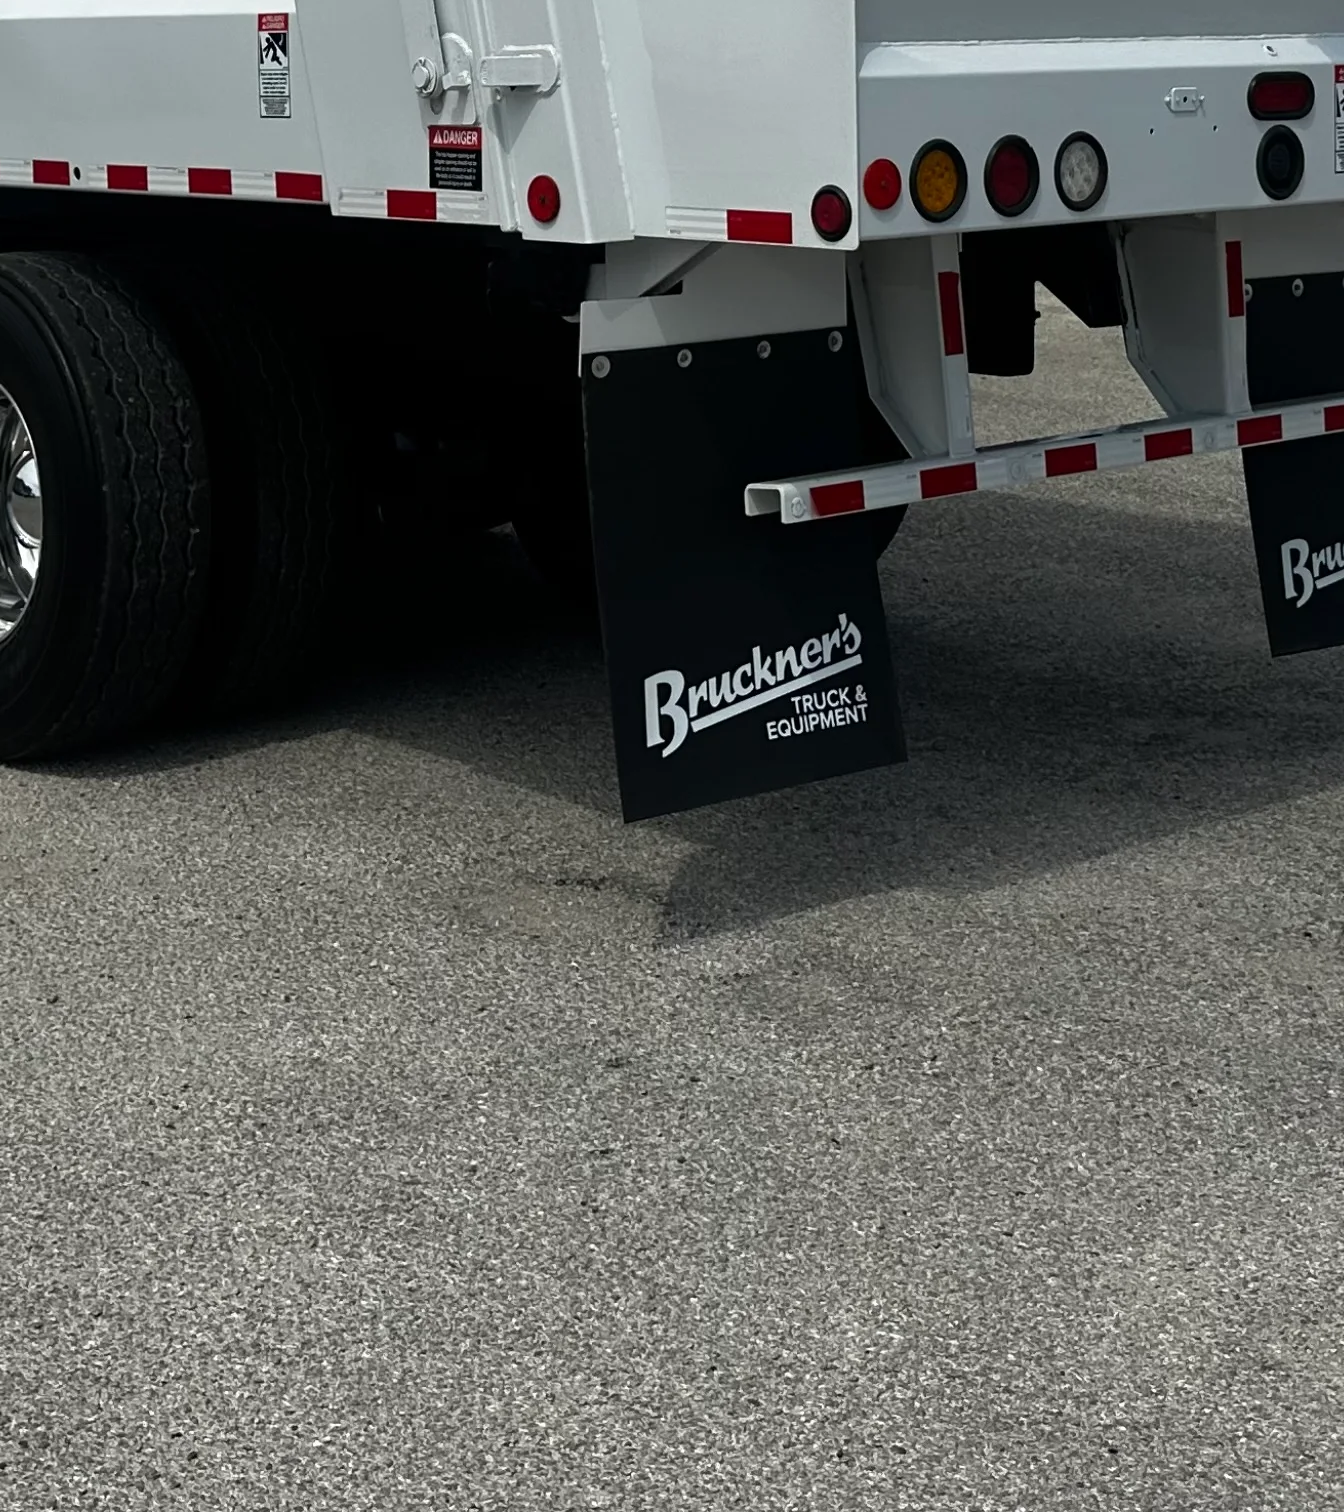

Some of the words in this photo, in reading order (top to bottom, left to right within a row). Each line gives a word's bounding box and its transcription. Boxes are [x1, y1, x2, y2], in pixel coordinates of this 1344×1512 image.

[443, 130, 478, 145] DANGER
[644, 613, 862, 758] Bruckner's
[790, 687, 849, 714] TRUCK
[854, 684, 867, 701] &
[766, 703, 869, 740] EQUIPMENT
